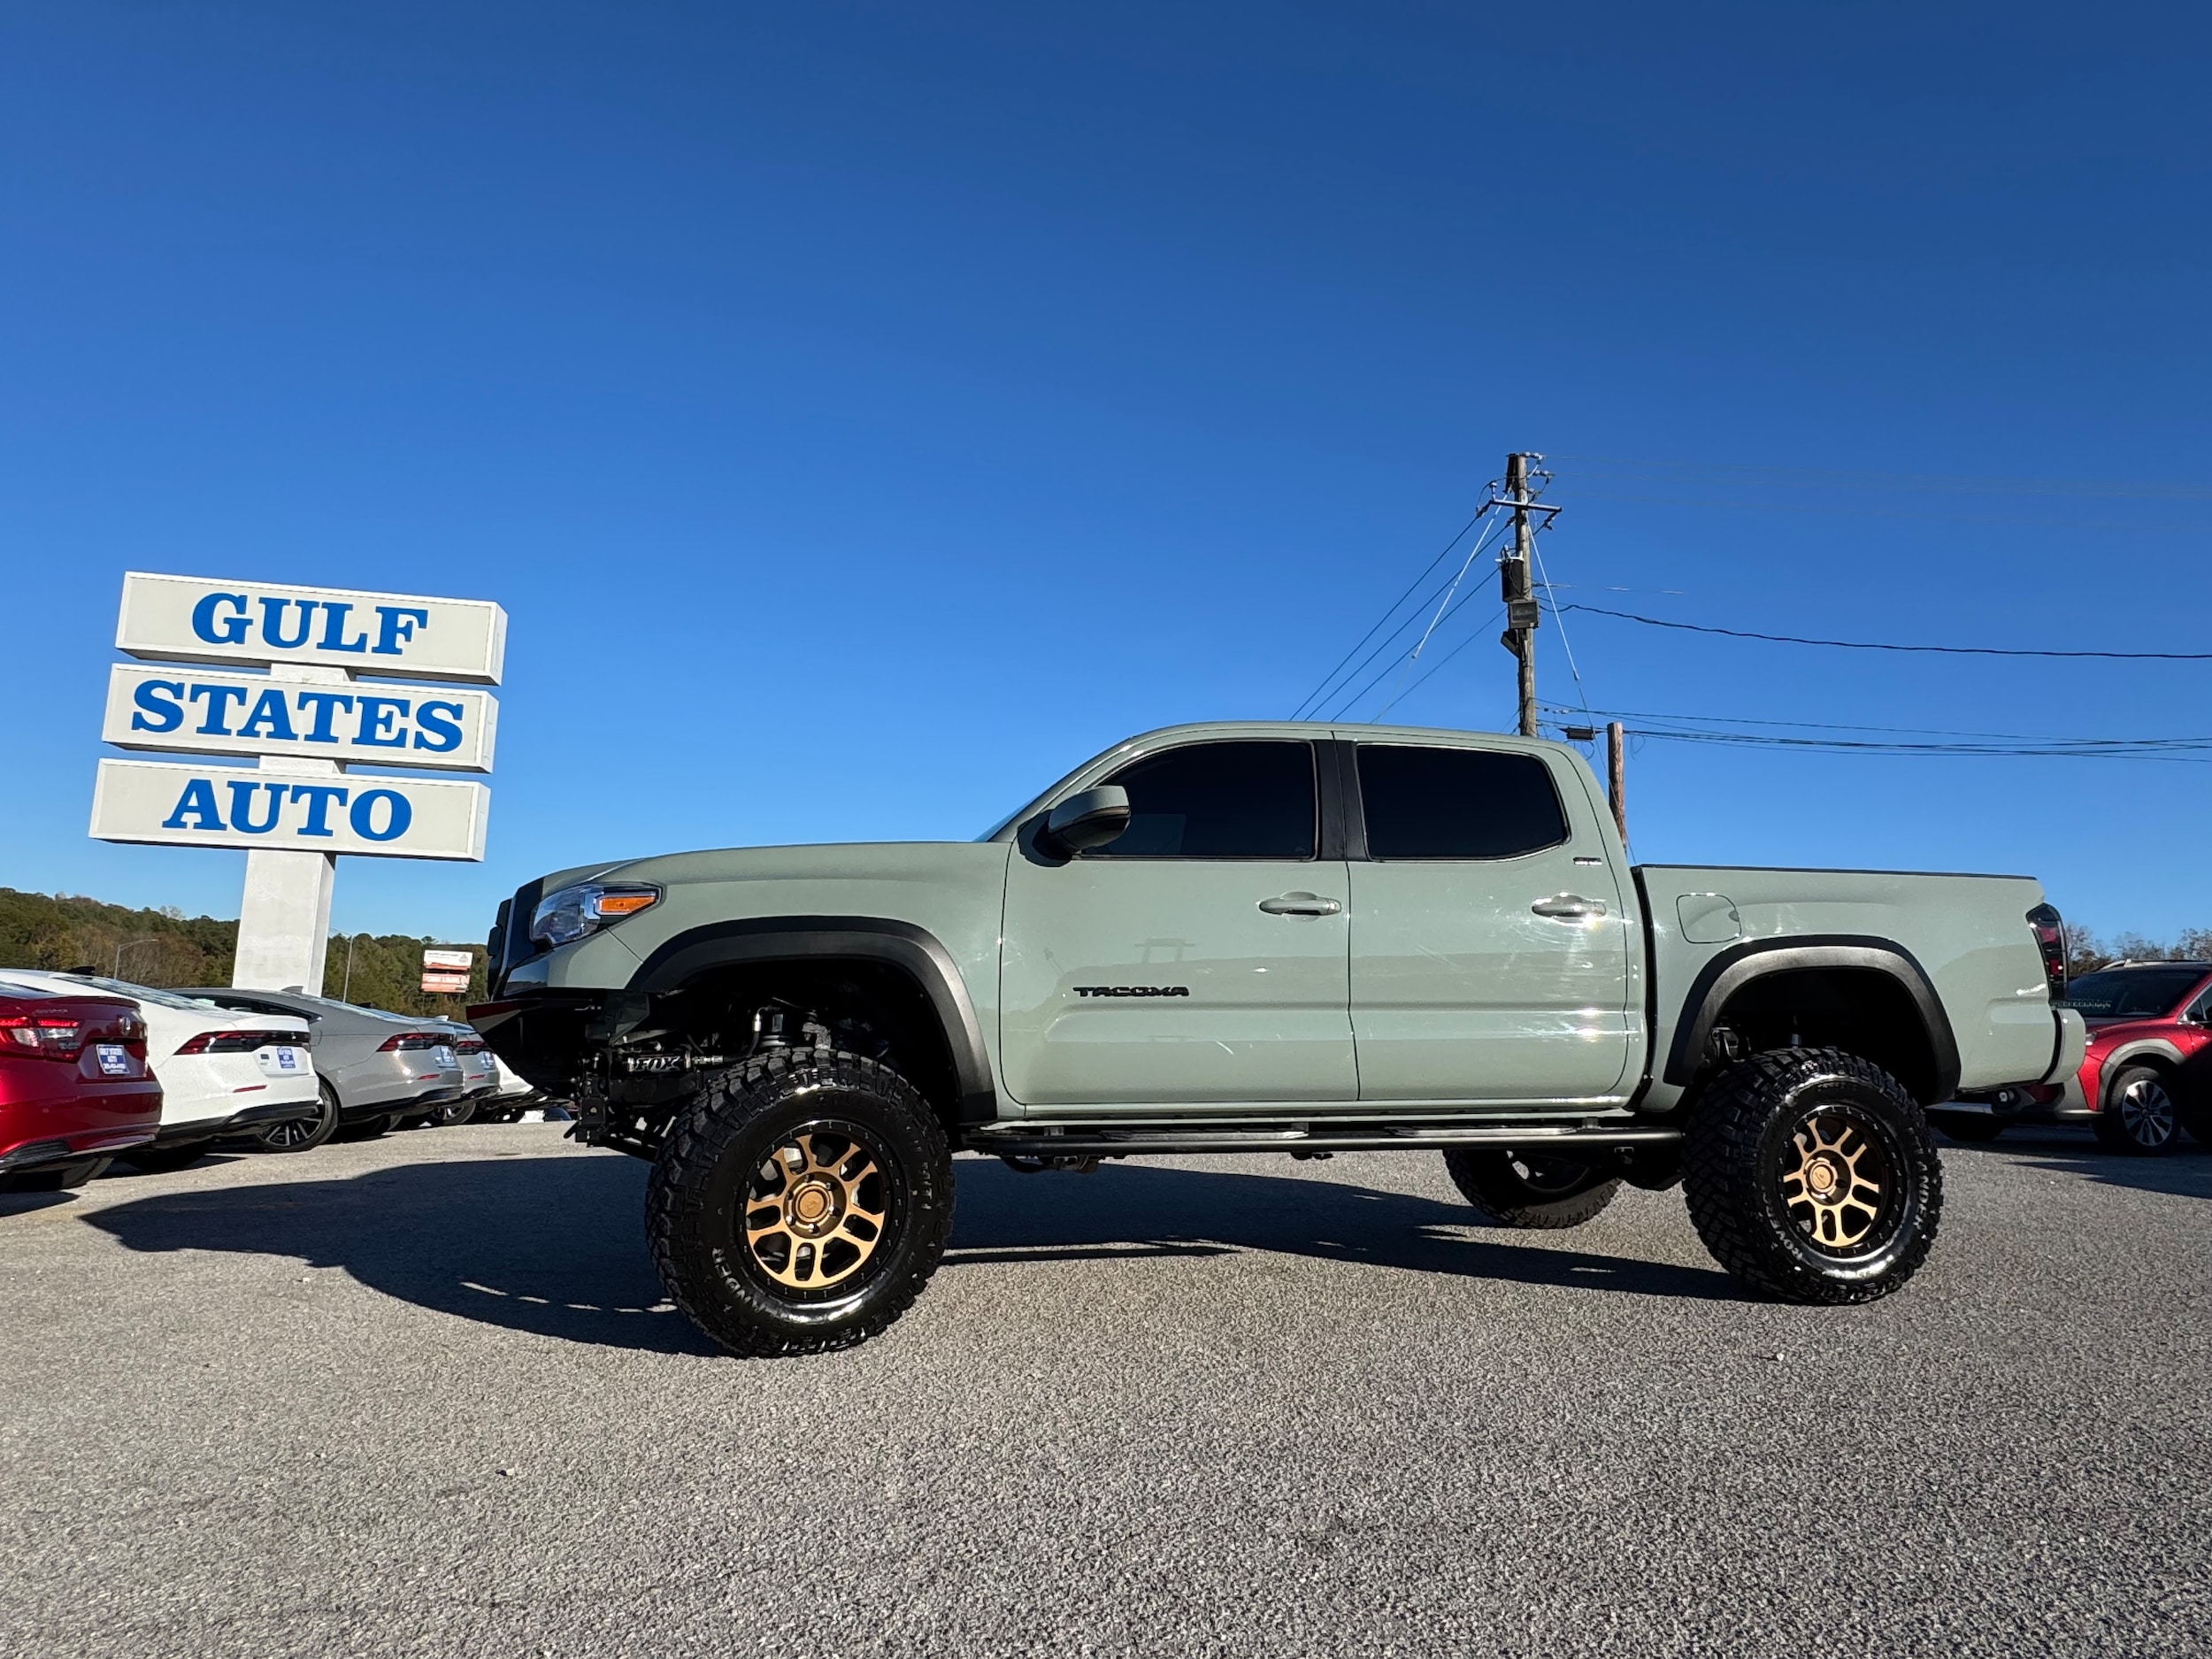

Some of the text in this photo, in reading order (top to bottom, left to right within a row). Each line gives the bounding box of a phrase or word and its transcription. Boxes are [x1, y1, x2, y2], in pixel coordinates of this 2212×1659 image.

[191, 592, 428, 656] GULF
[131, 680, 464, 754] STATES
[162, 779, 412, 842] AUTO
[1073, 987, 1189, 997] TACOMA
